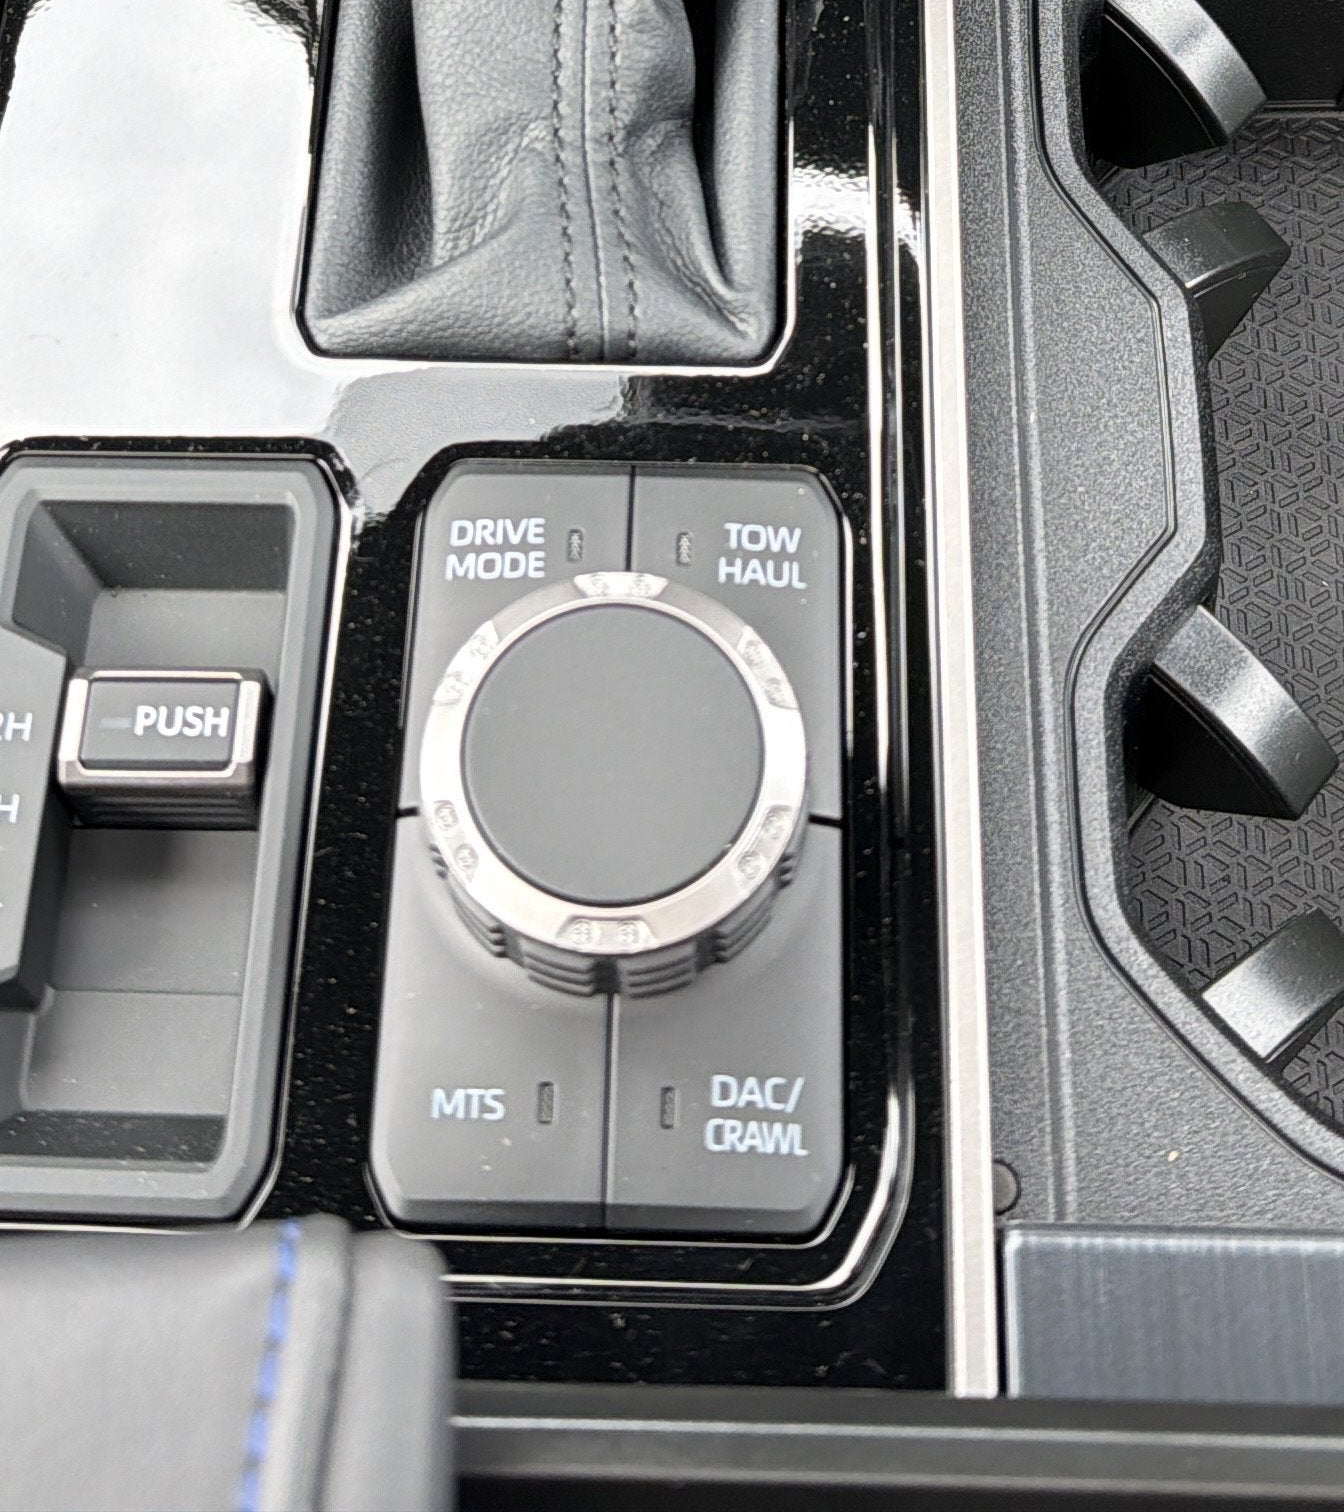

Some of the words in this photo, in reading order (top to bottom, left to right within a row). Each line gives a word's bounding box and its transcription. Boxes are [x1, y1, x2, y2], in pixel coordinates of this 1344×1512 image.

[449, 517, 545, 548] DRIVE
[724, 522, 802, 554] TOW
[444, 552, 546, 581] MODE
[717, 556, 807, 590] HAUL
[133, 704, 230, 739] PUSH
[431, 1088, 505, 1120] MTS
[708, 1074, 805, 1114] DAC/
[704, 1117, 810, 1157] CRAWL
